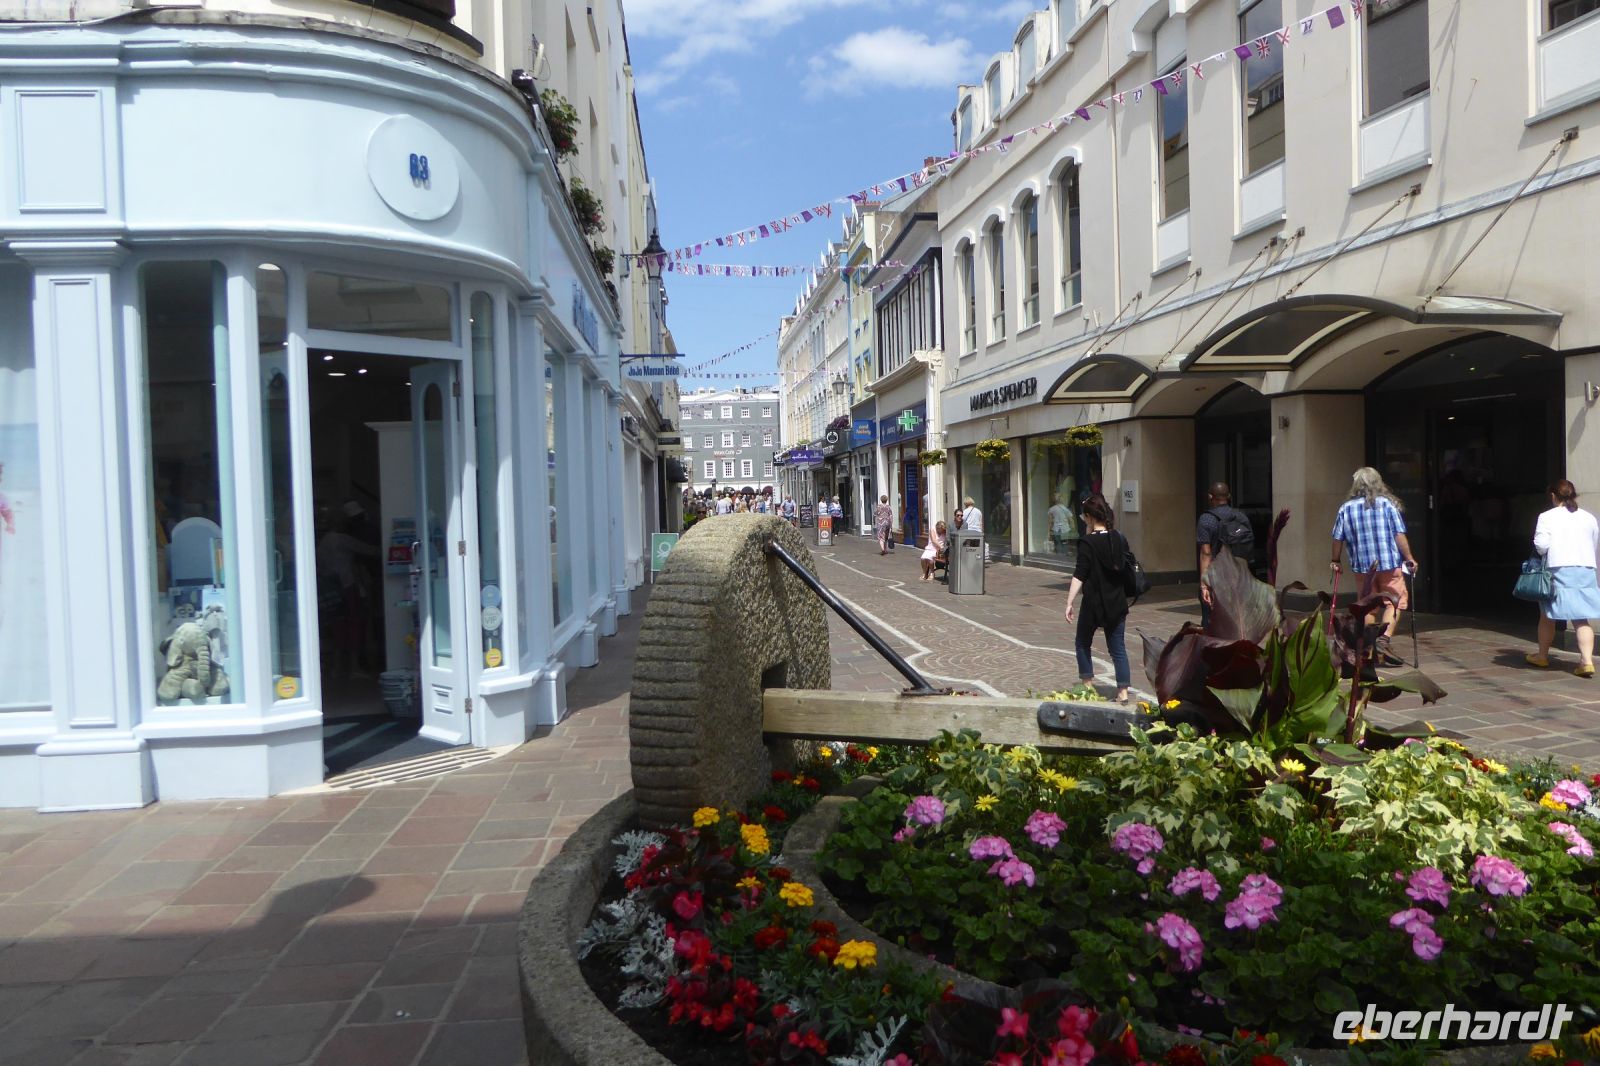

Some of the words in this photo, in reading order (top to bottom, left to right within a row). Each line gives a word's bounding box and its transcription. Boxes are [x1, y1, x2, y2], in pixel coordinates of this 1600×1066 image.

[628, 366, 642, 376] JoJo
[643, 365, 665, 376] Maman
[969, 389, 993, 411] MARKS
[993, 388, 1000, 405] &
[999, 377, 1038, 404] SPENCER
